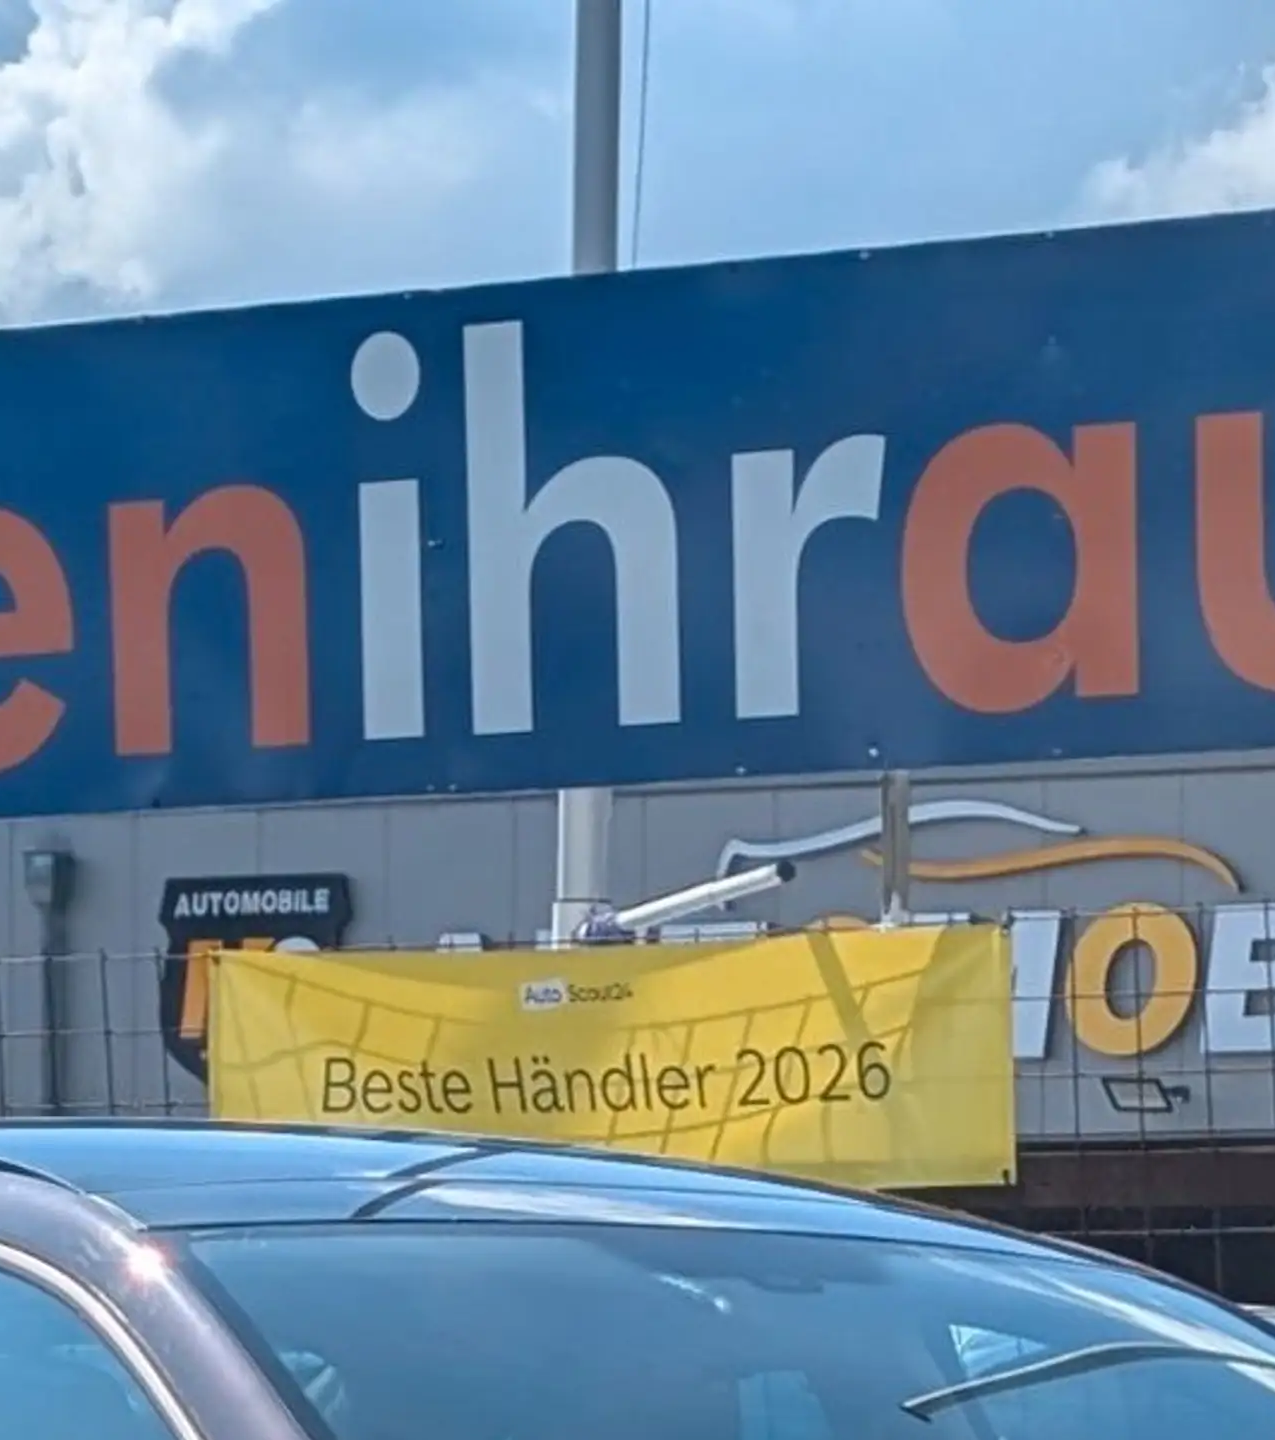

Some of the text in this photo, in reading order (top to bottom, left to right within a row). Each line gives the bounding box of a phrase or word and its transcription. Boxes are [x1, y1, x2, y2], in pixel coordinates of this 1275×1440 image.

[174, 888, 331, 918] AUTOMOBILE
[320, 1041, 892, 1115] Beste Händler 2026
